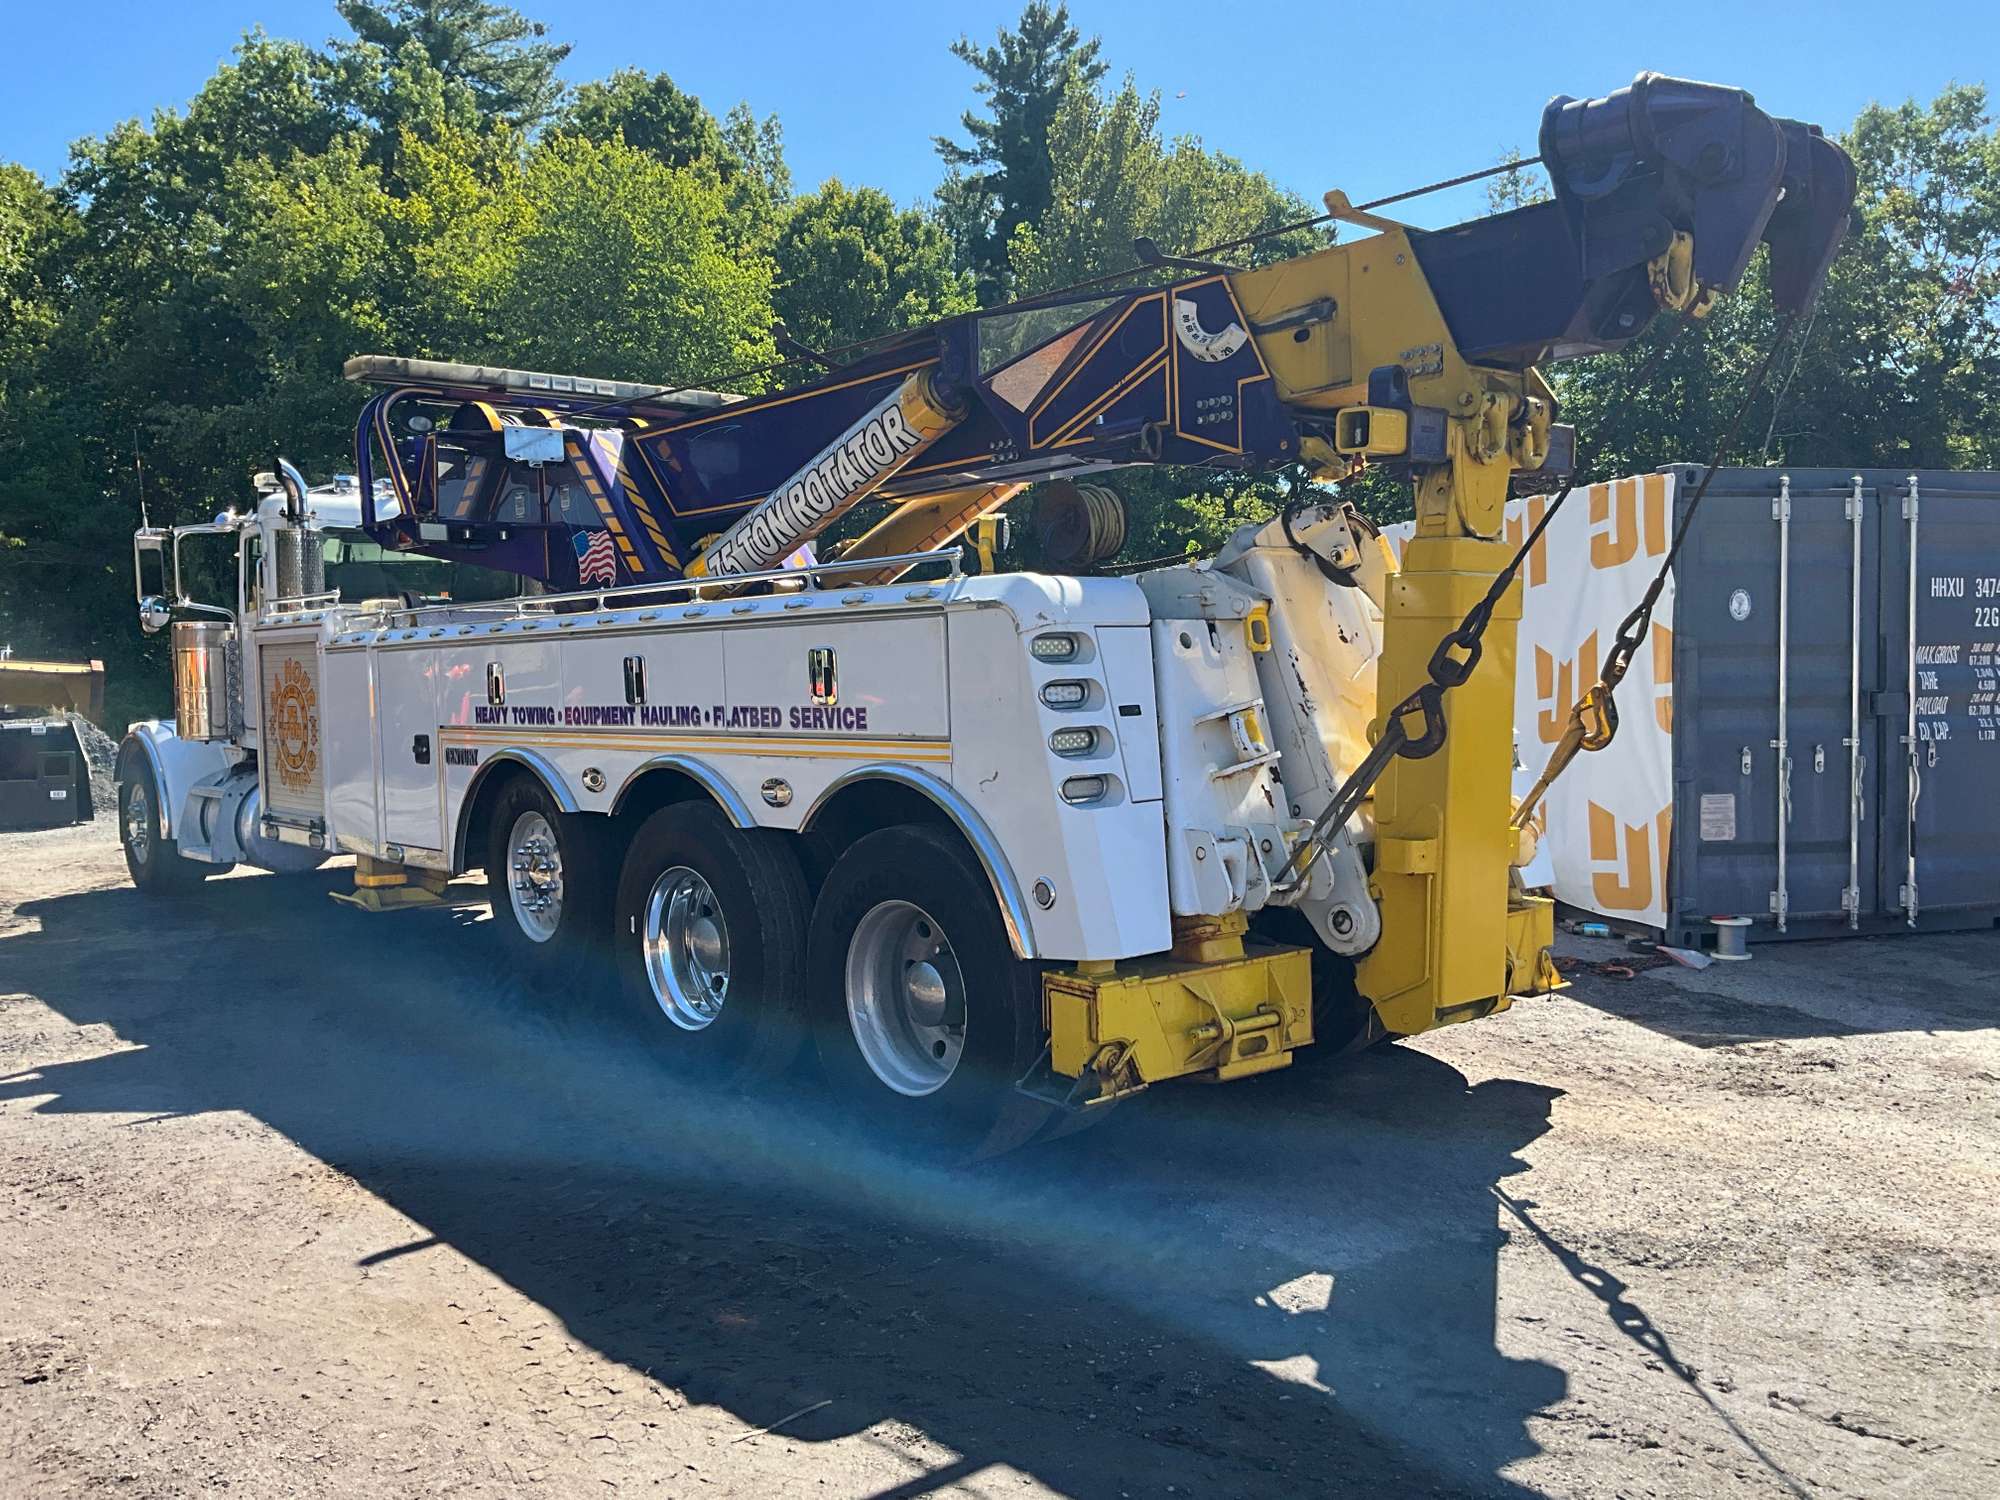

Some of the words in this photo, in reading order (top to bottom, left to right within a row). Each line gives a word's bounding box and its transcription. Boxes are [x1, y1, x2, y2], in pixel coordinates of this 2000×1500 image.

[708, 540, 747, 591] 75
[736, 498, 801, 567] TON
[786, 403, 921, 529] ROTATOR
[1931, 577, 1964, 597] HHXU
[1975, 607, 1999, 627] 22G
[1918, 671, 1939, 690] TARE
[1914, 696, 1949, 715] PAYLOAD
[475, 706, 509, 724] HEAVY
[511, 706, 555, 725] TOWING
[564, 706, 636, 726] EQUIPMENT
[640, 706, 700, 727] HAULING
[712, 706, 783, 728] FLATBED
[789, 706, 868, 730] SERVICE
